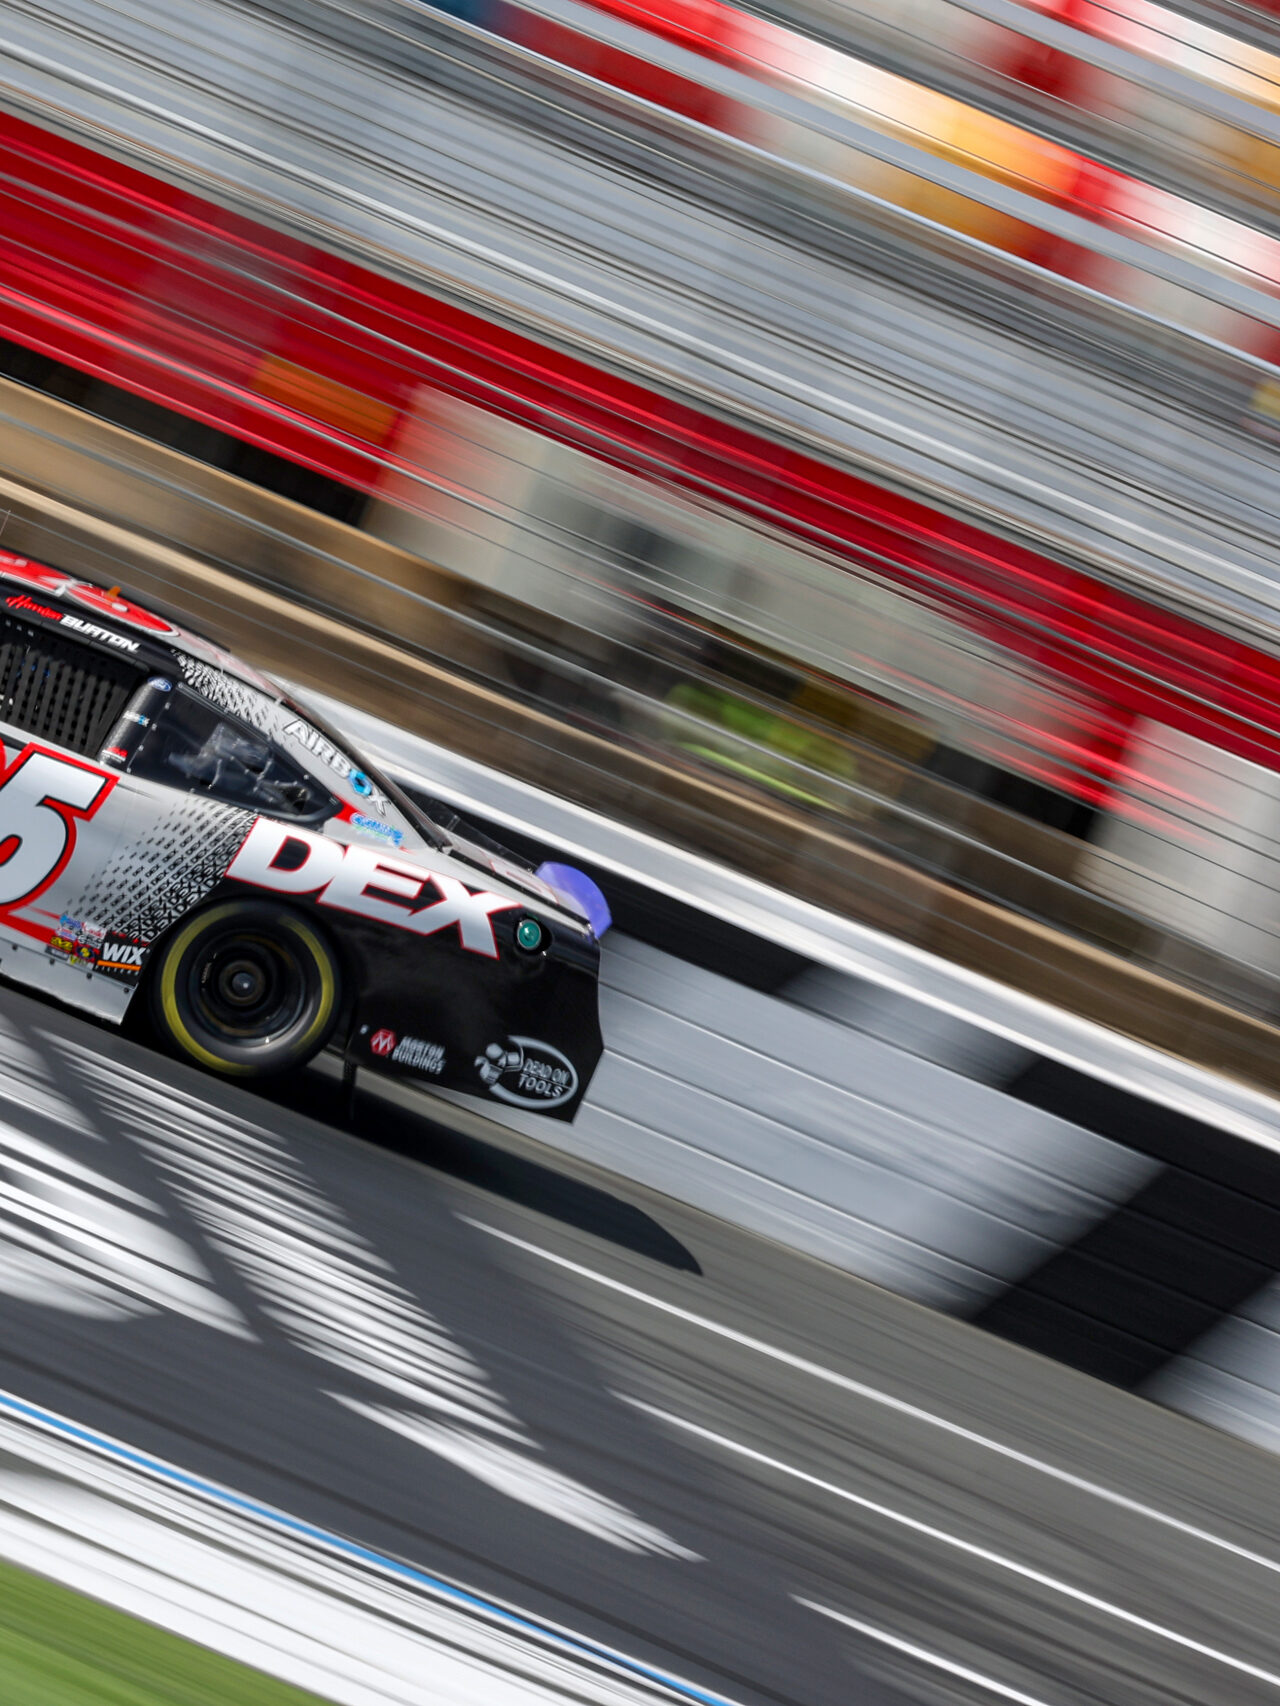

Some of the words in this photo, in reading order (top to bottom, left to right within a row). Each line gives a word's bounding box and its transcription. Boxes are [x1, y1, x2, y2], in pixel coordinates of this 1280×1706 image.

[60, 613, 142, 653] BURTON
[282, 719, 391, 817] AIRBOX
[225, 816, 523, 960] DEX
[102, 942, 147, 965] WIX
[391, 1046, 447, 1075] BUILDINGS
[399, 1036, 445, 1060] MORTON
[519, 1073, 564, 1098] TOOLS
[523, 1058, 553, 1079] DEAD
[551, 1068, 570, 1085] ON
